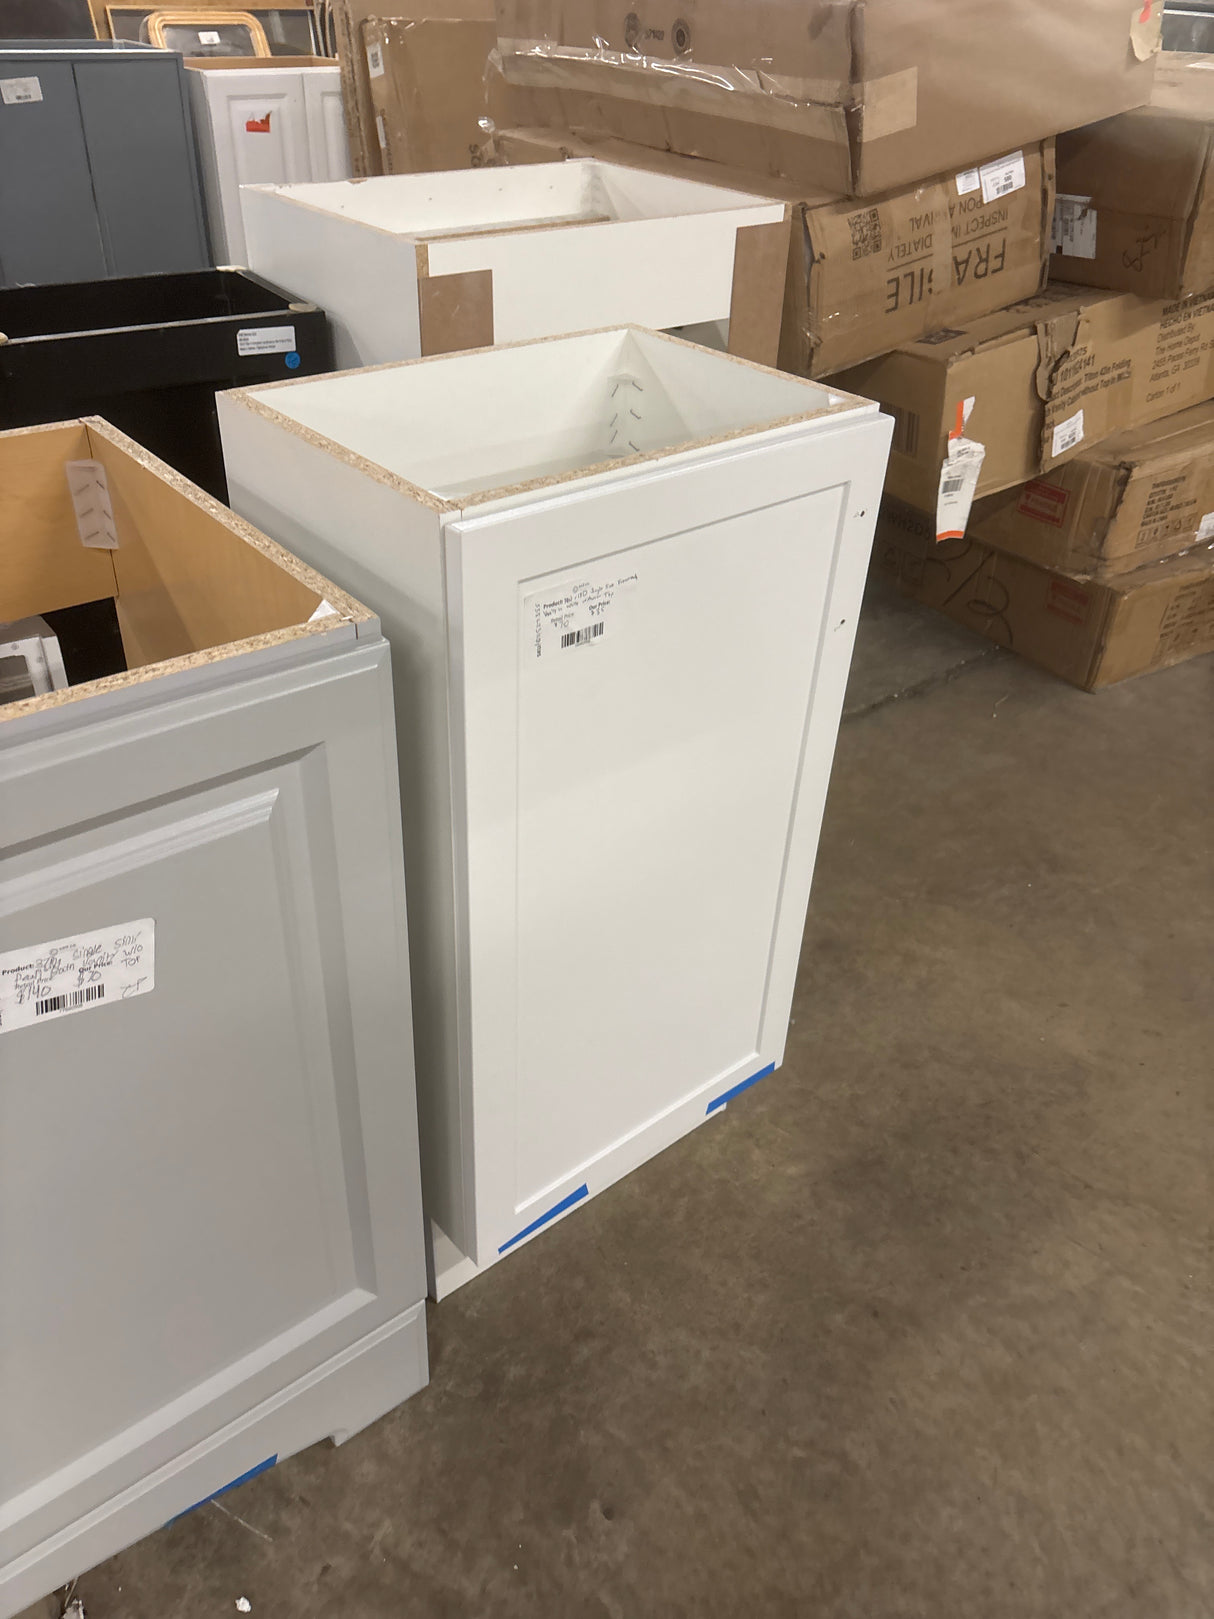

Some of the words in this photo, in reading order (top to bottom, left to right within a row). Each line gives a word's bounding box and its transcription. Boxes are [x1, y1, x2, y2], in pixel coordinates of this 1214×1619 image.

[958, 196, 985, 215] PON
[964, 207, 1009, 236] INSPECT
[885, 238, 1006, 314] FRAILE
